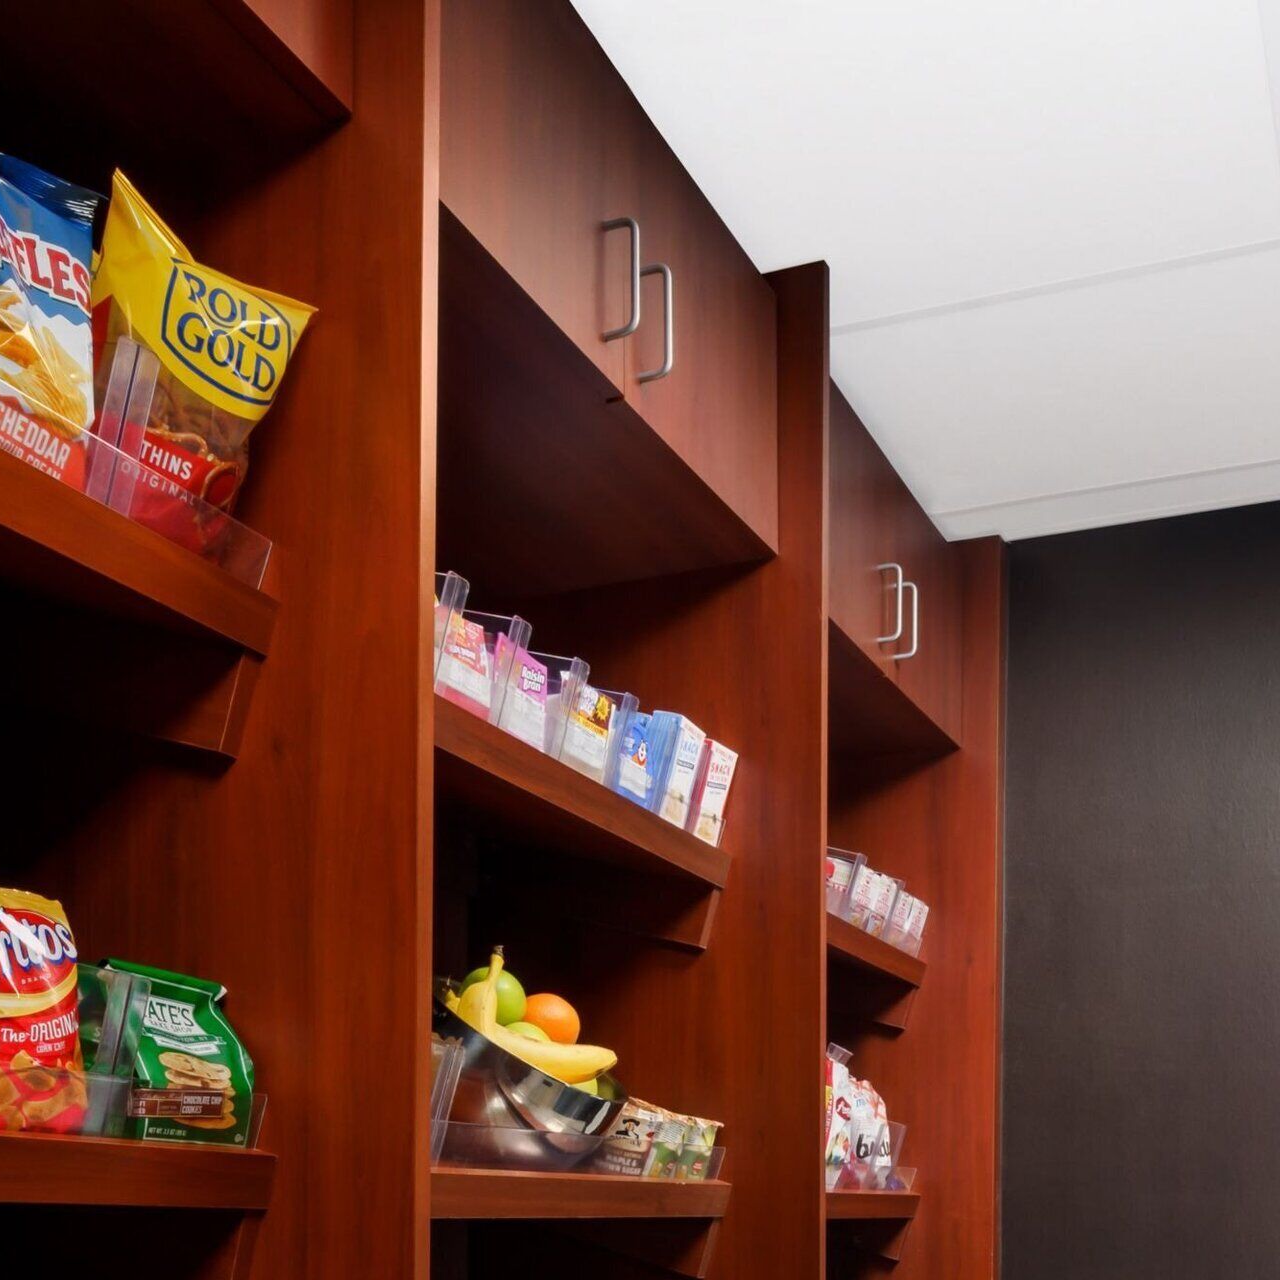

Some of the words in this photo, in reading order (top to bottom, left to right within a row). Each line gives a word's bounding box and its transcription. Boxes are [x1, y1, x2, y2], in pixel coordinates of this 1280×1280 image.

[182, 270, 281, 351] ROLD
[177, 311, 276, 393] GOLD
[141, 439, 194, 481] THINS
[121, 461, 196, 507] ORIGINAL
[521, 664, 545, 686] Raisin
[522, 678, 542, 694] Bran
[0, 1027, 26, 1042] The
[30, 1007, 79, 1043] ORIGIN
[147, 999, 195, 1028] ATE'S
